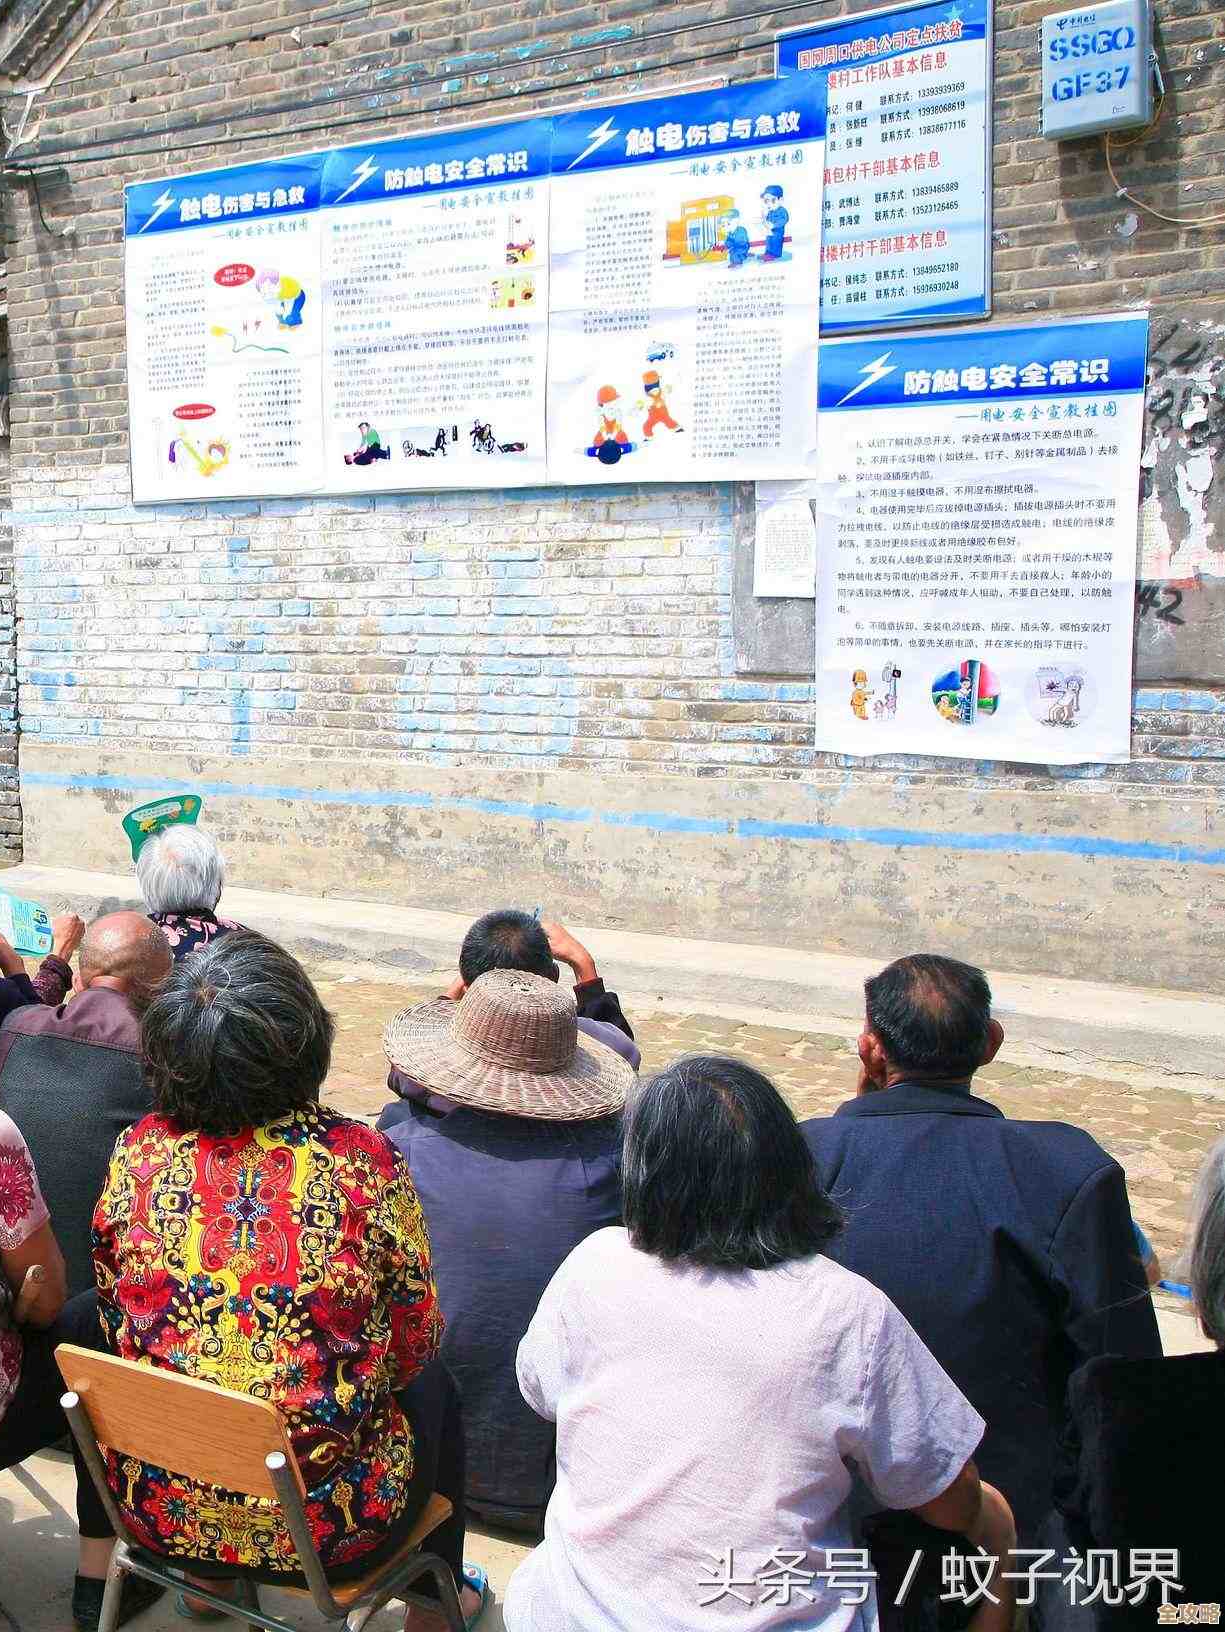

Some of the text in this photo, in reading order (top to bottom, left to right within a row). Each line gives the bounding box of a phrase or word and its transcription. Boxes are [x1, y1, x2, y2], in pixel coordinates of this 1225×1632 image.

[798, 19, 964, 70] 国网周口供电公司定点扶贫
[1052, 66, 1129, 101] GF37
[625, 110, 802, 156] 触电伤害与急救
[384, 150, 528, 191] 防触电安全常识
[180, 184, 306, 222] 触电伤害与急救
[903, 358, 1110, 395] 防触电安全常识
